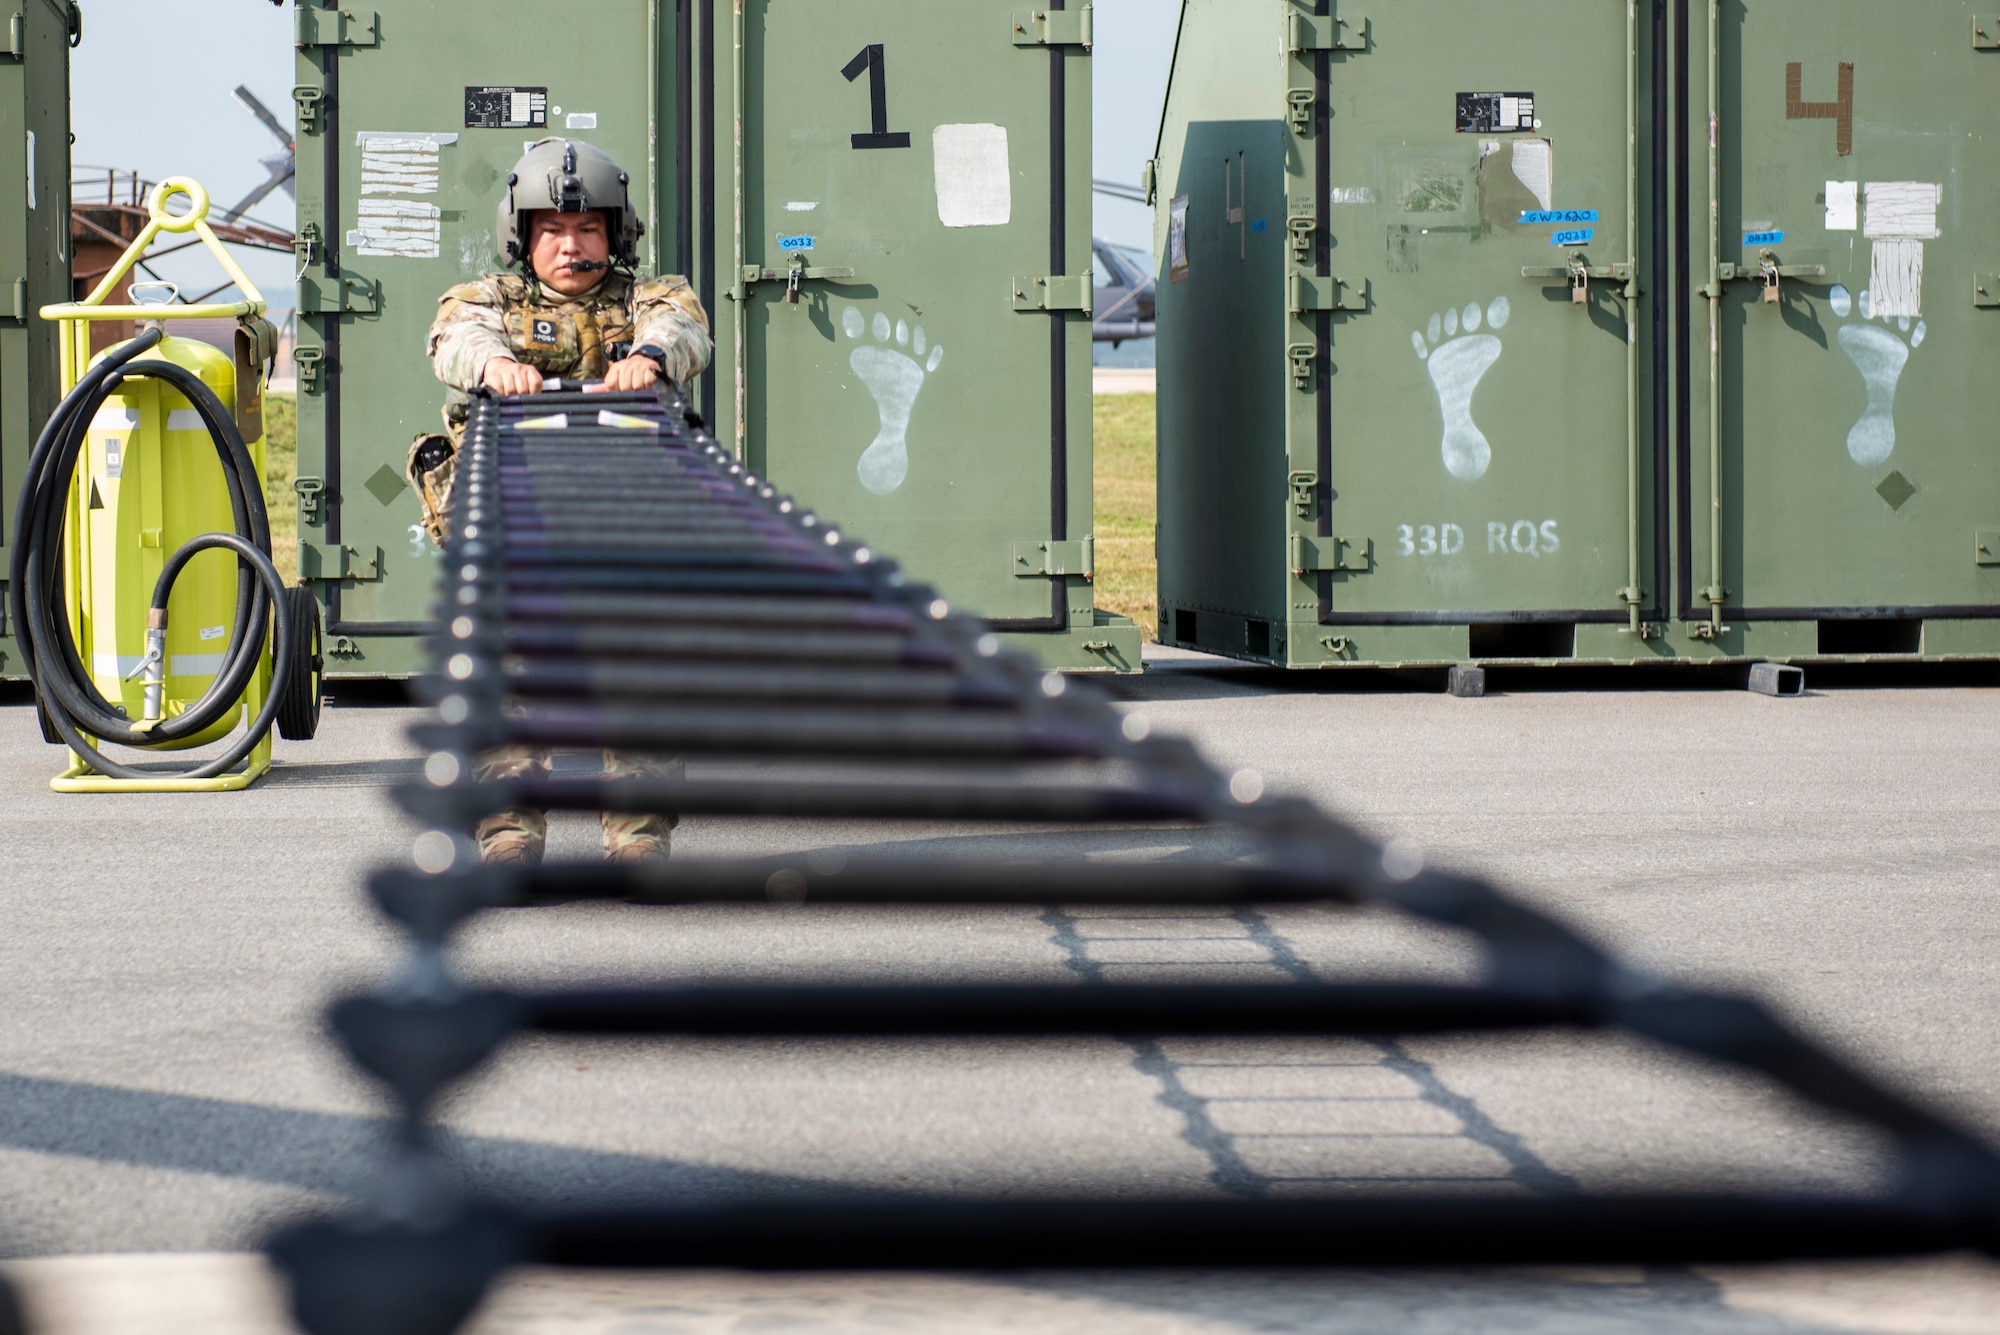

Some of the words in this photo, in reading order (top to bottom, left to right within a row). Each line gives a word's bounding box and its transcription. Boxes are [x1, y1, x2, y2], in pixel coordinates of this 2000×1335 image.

[840, 43, 911, 149] 1
[1785, 62, 1854, 156] 4
[783, 237, 812, 247] 0033
[1557, 230, 1586, 242] 0033
[1487, 519, 1560, 559] RQS
